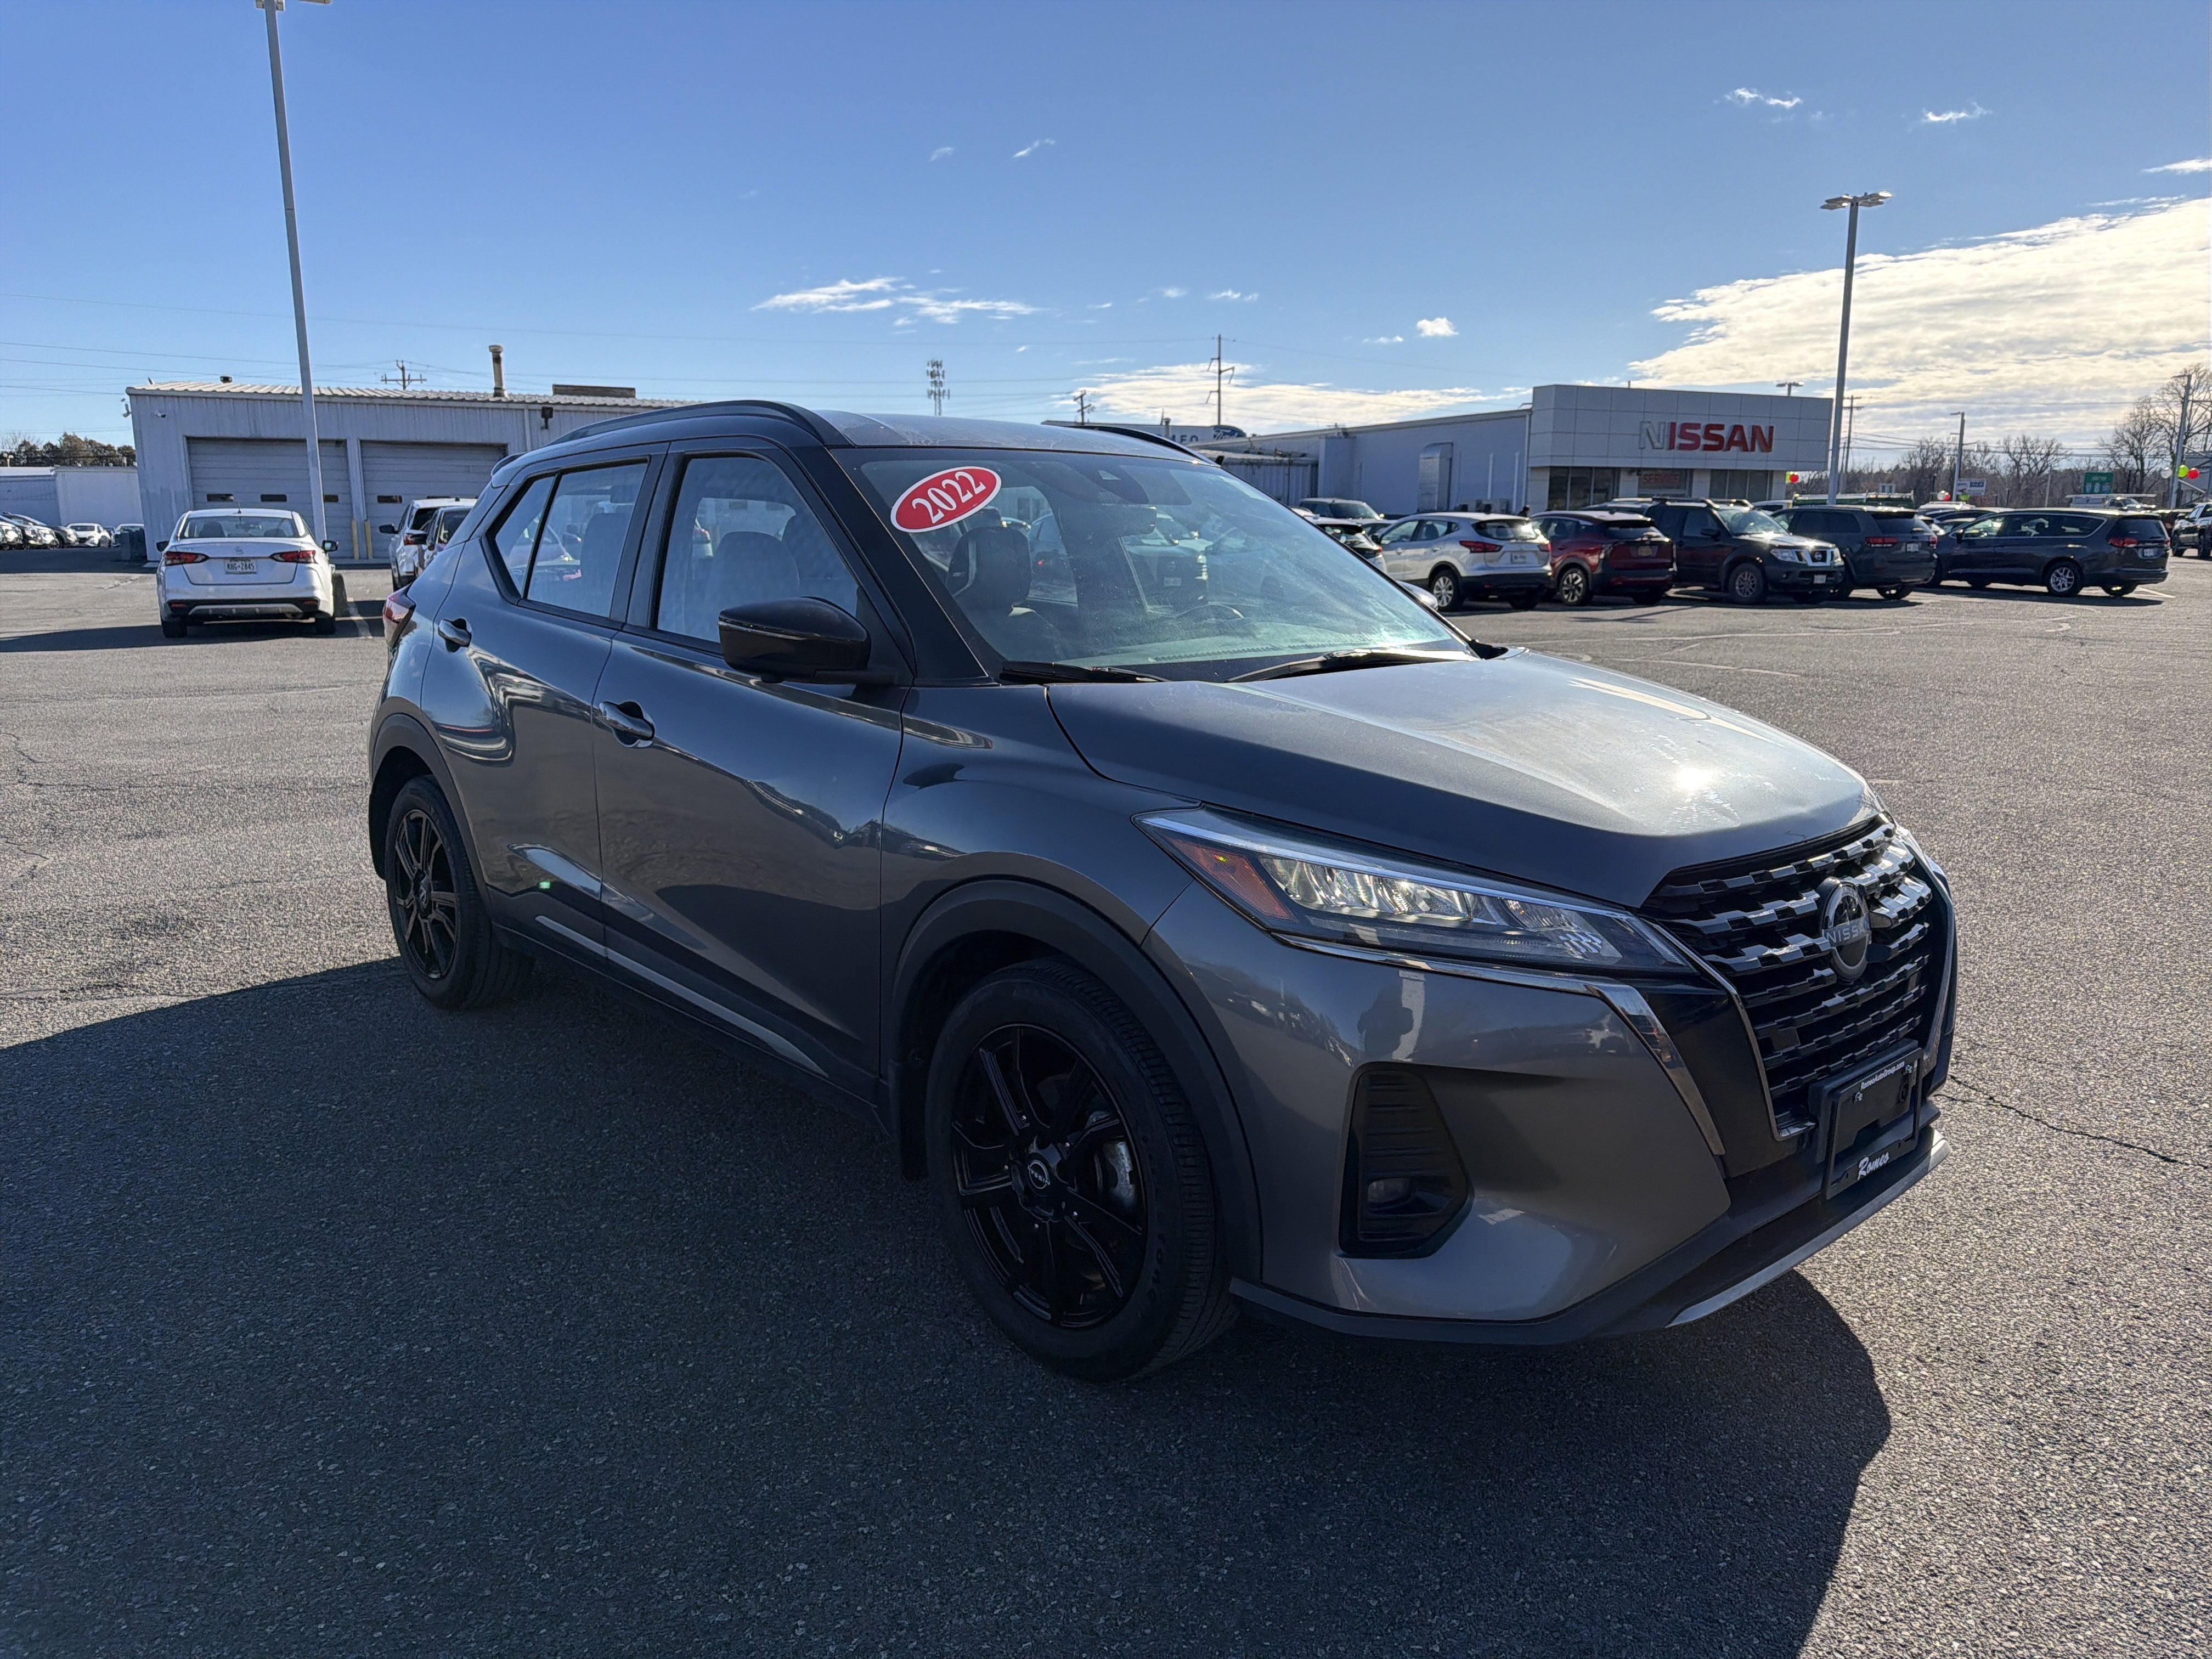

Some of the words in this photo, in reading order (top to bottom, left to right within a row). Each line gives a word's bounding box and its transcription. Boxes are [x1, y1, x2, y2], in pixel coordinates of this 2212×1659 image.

[1639, 421, 1774, 452] NISSAN
[912, 472, 986, 524] 2022
[1857, 1152, 1889, 1181] Romeo
